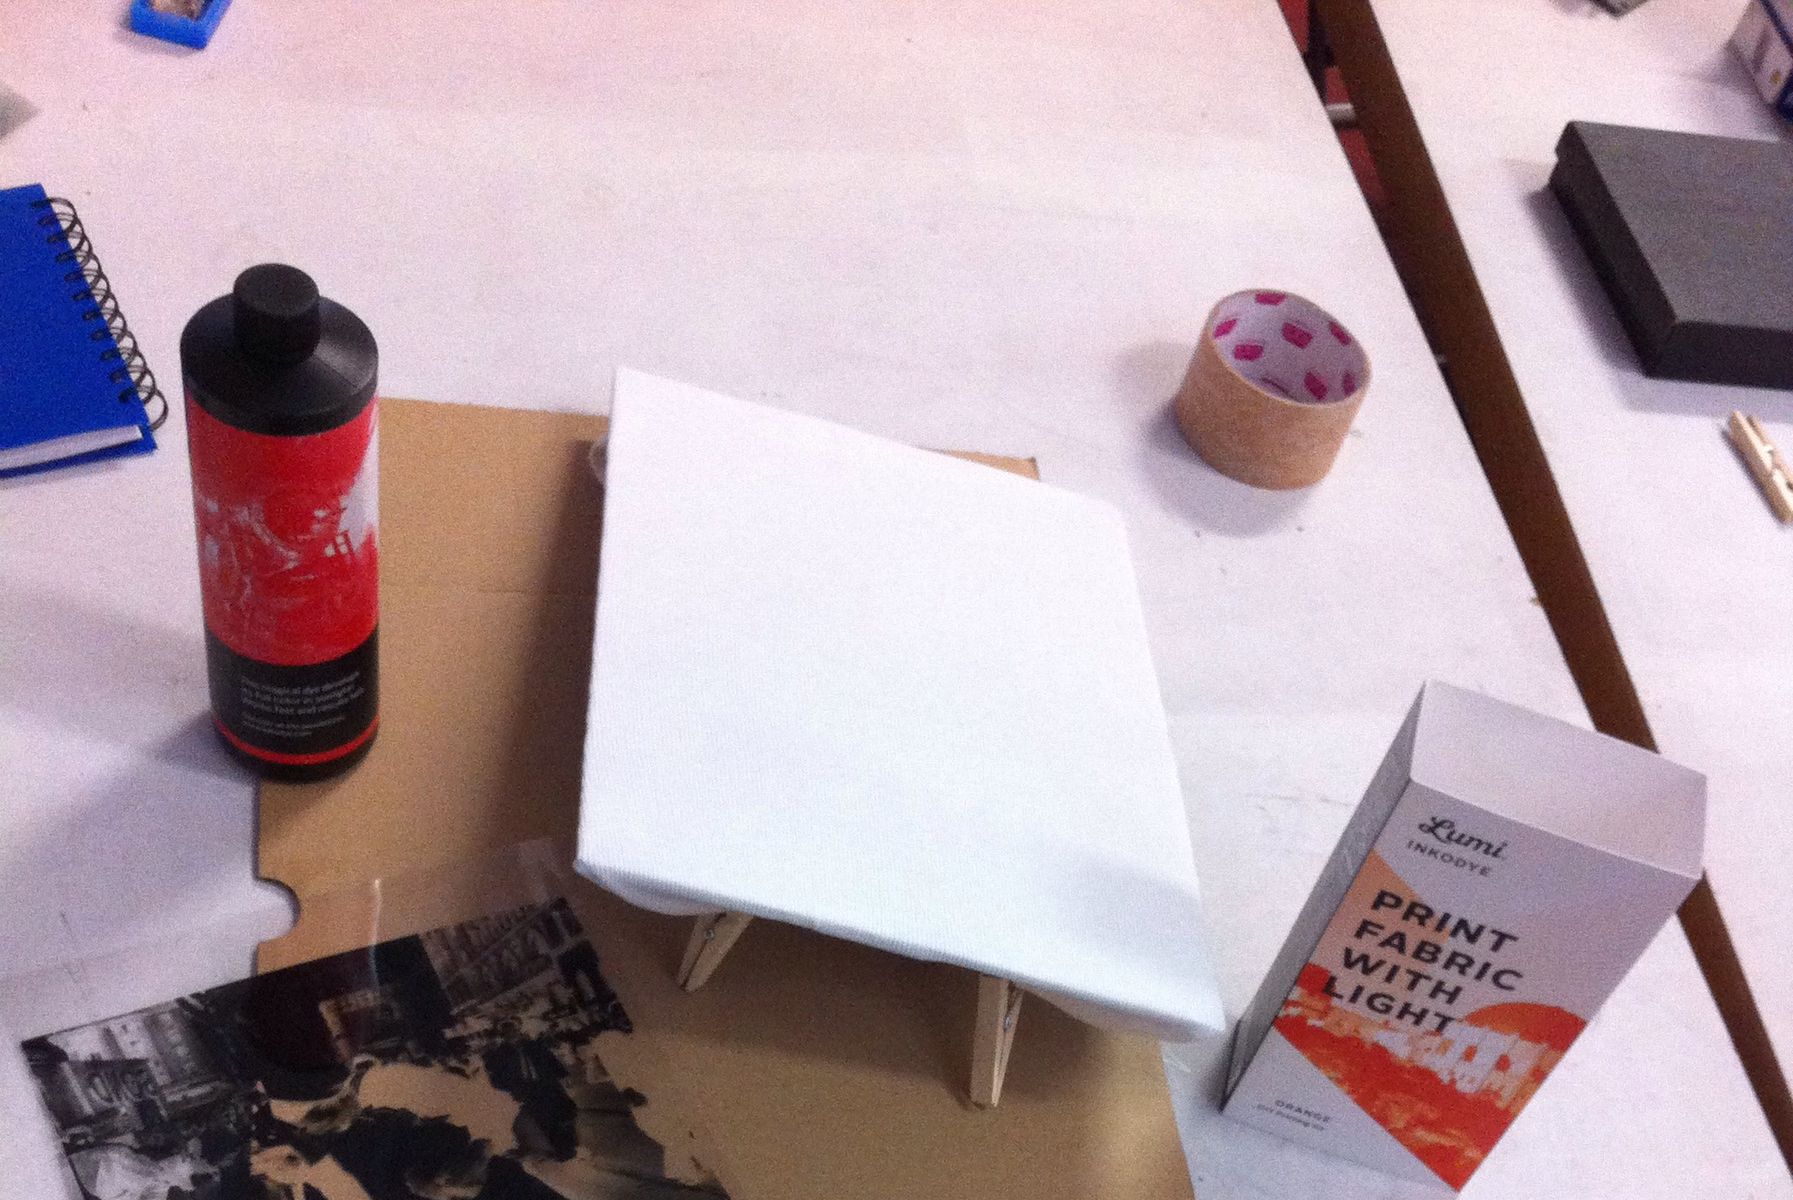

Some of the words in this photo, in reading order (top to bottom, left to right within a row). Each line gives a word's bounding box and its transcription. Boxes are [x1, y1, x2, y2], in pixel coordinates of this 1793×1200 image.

[1408, 840, 1490, 877] INKODYE
[1418, 816, 1508, 860] Lumi
[1371, 890, 1519, 953] PRINT
[1343, 947, 1464, 1005] WITH
[1354, 919, 1524, 991] FABRIC
[1322, 975, 1456, 1034] LIGHT
[1275, 1100, 1330, 1122] ORANGE
